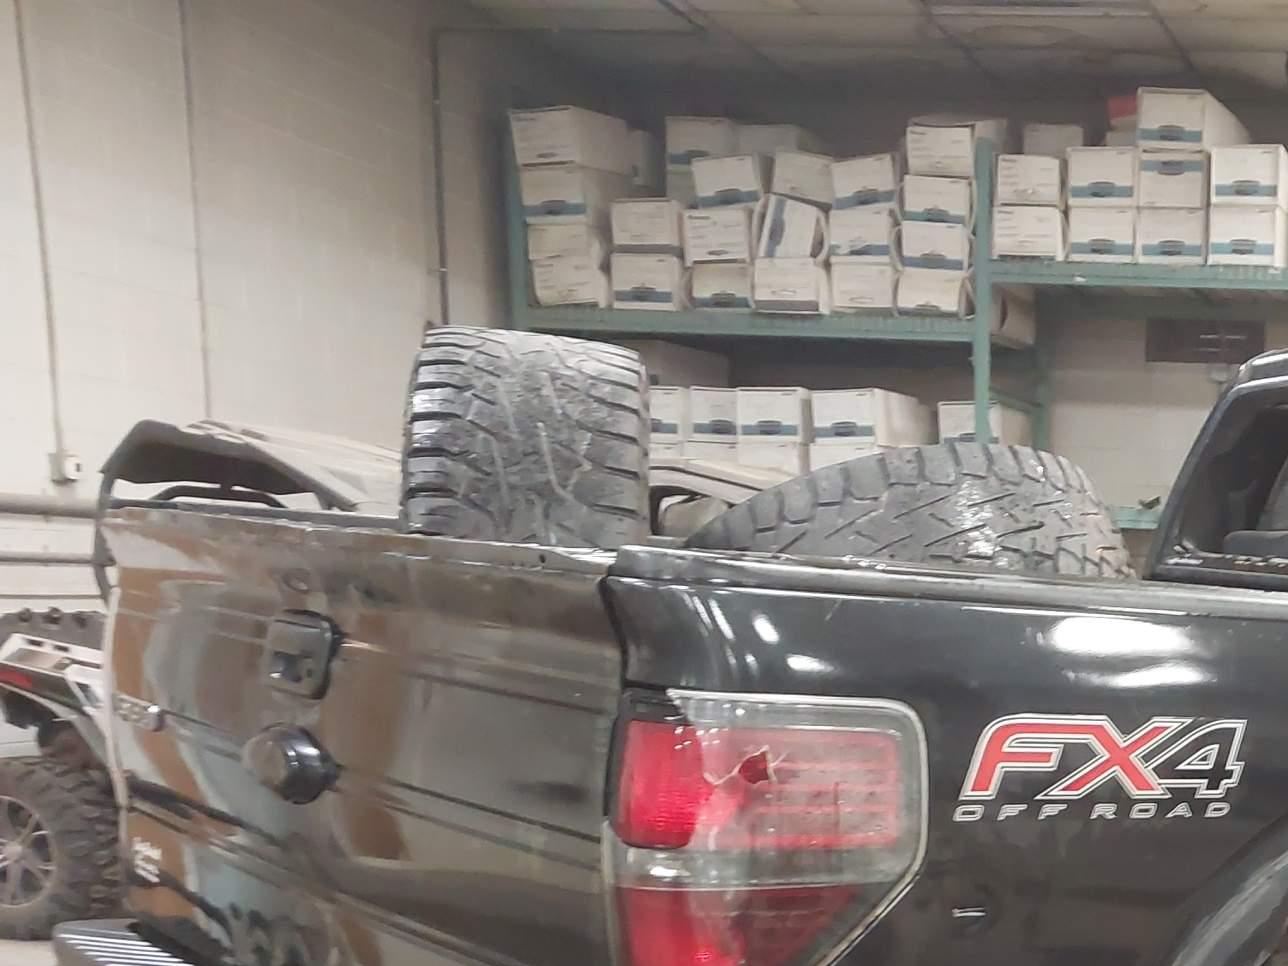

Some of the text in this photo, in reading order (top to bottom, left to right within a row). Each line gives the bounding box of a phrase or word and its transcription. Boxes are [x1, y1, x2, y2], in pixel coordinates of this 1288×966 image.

[958, 712, 1248, 801] FX4
[952, 801, 1233, 823] OFF ROAD
